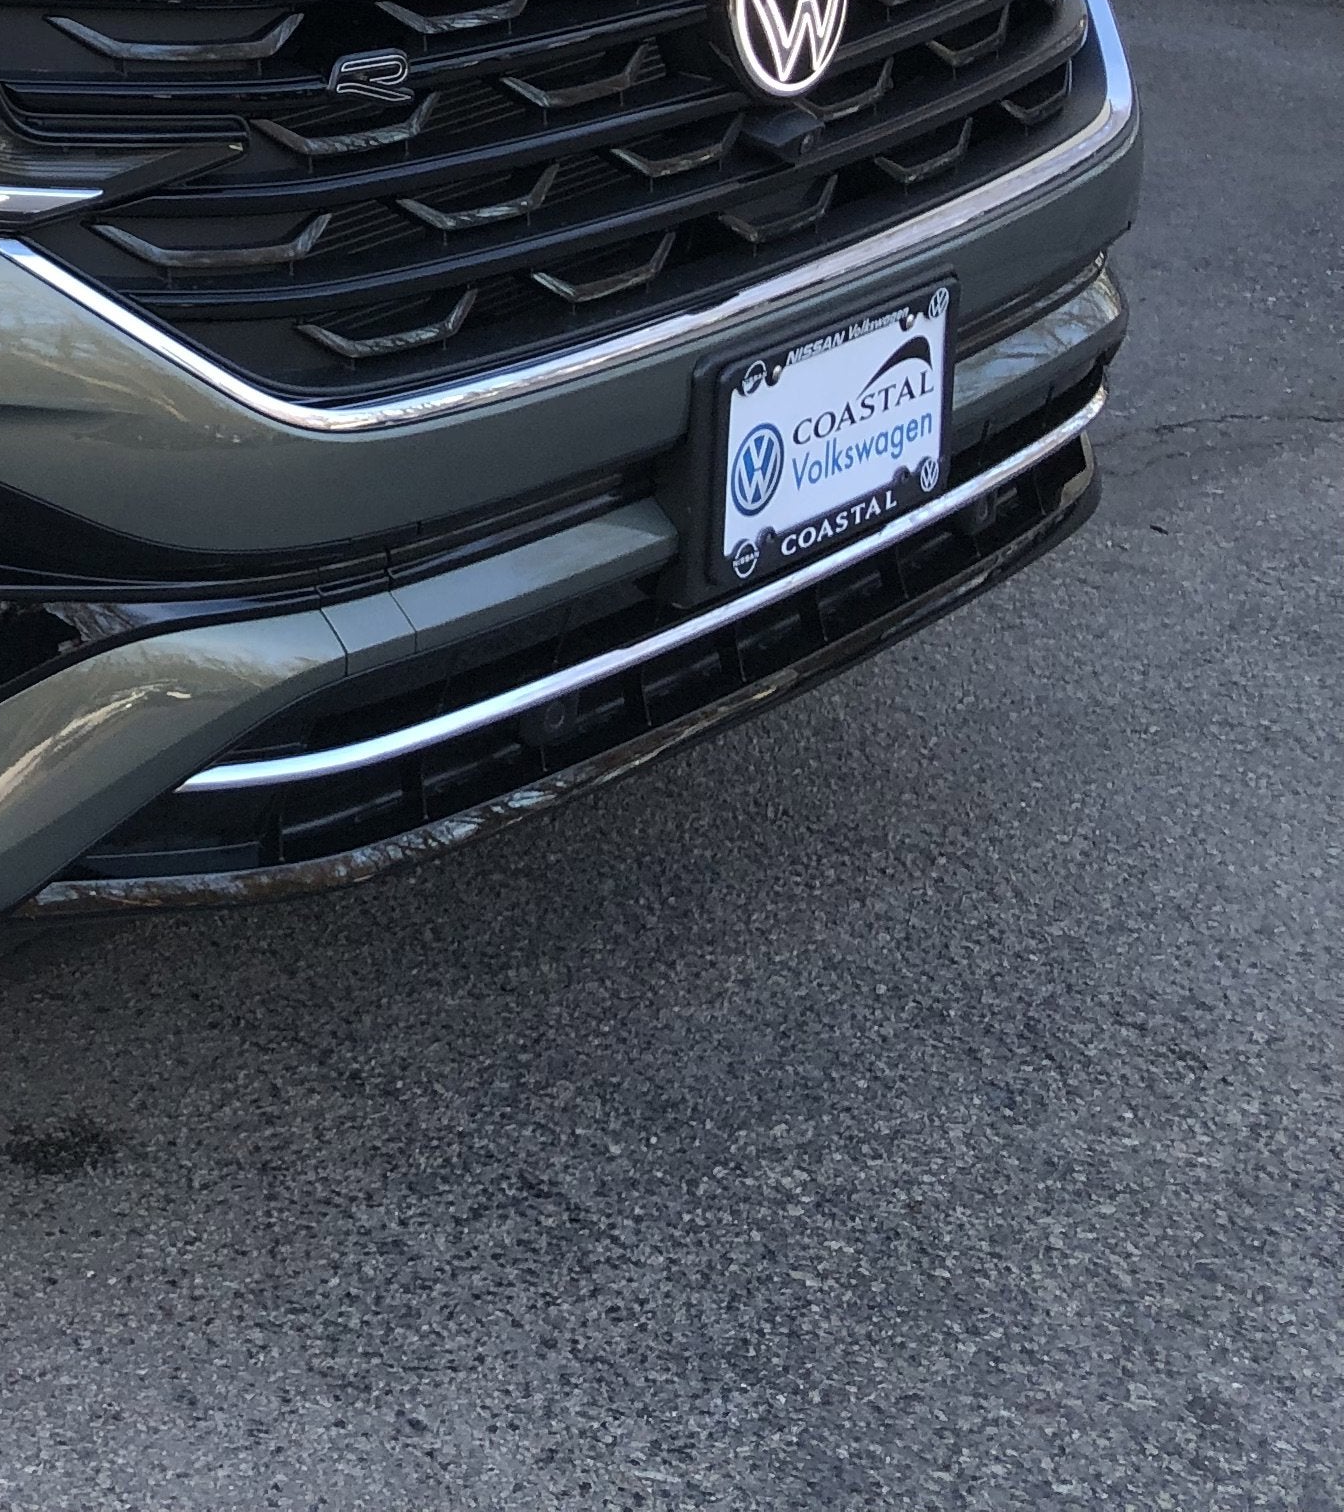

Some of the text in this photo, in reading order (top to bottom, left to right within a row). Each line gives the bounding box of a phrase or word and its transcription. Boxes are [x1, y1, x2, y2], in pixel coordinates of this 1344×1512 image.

[786, 330, 846, 367] NISSAN
[792, 370, 935, 446] COASTAL
[791, 411, 933, 491] Volkswagen
[780, 489, 898, 557] COASTAL
